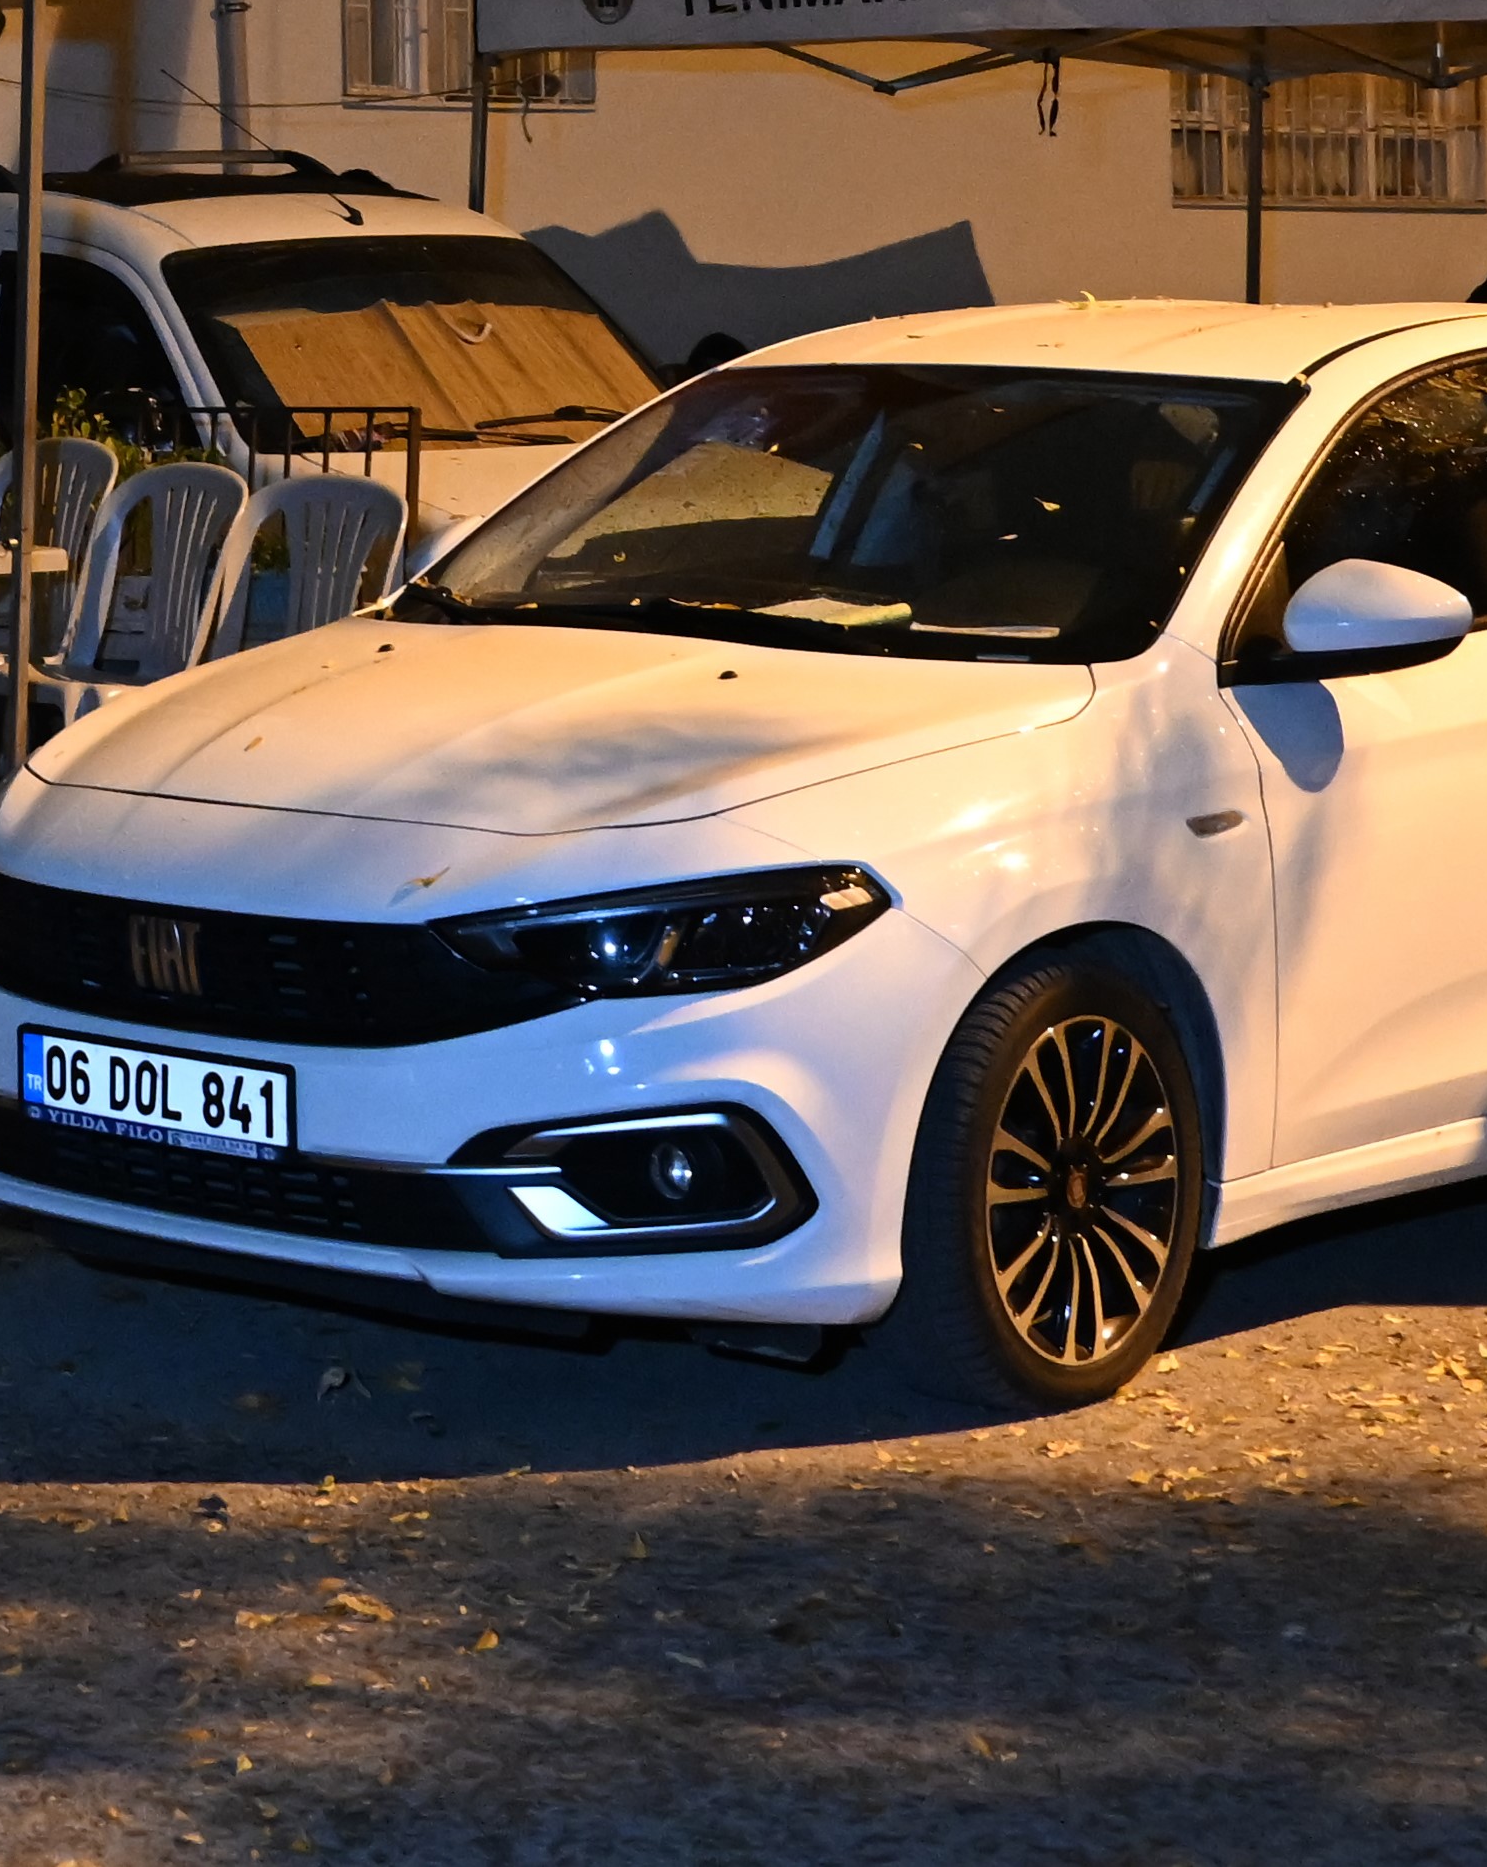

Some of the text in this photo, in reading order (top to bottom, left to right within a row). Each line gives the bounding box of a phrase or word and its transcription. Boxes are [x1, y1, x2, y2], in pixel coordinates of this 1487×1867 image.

[129, 914, 203, 996] FIAT
[27, 1045, 274, 1139] TR 06 DOL 841
[48, 1107, 108, 1133] YILDA
